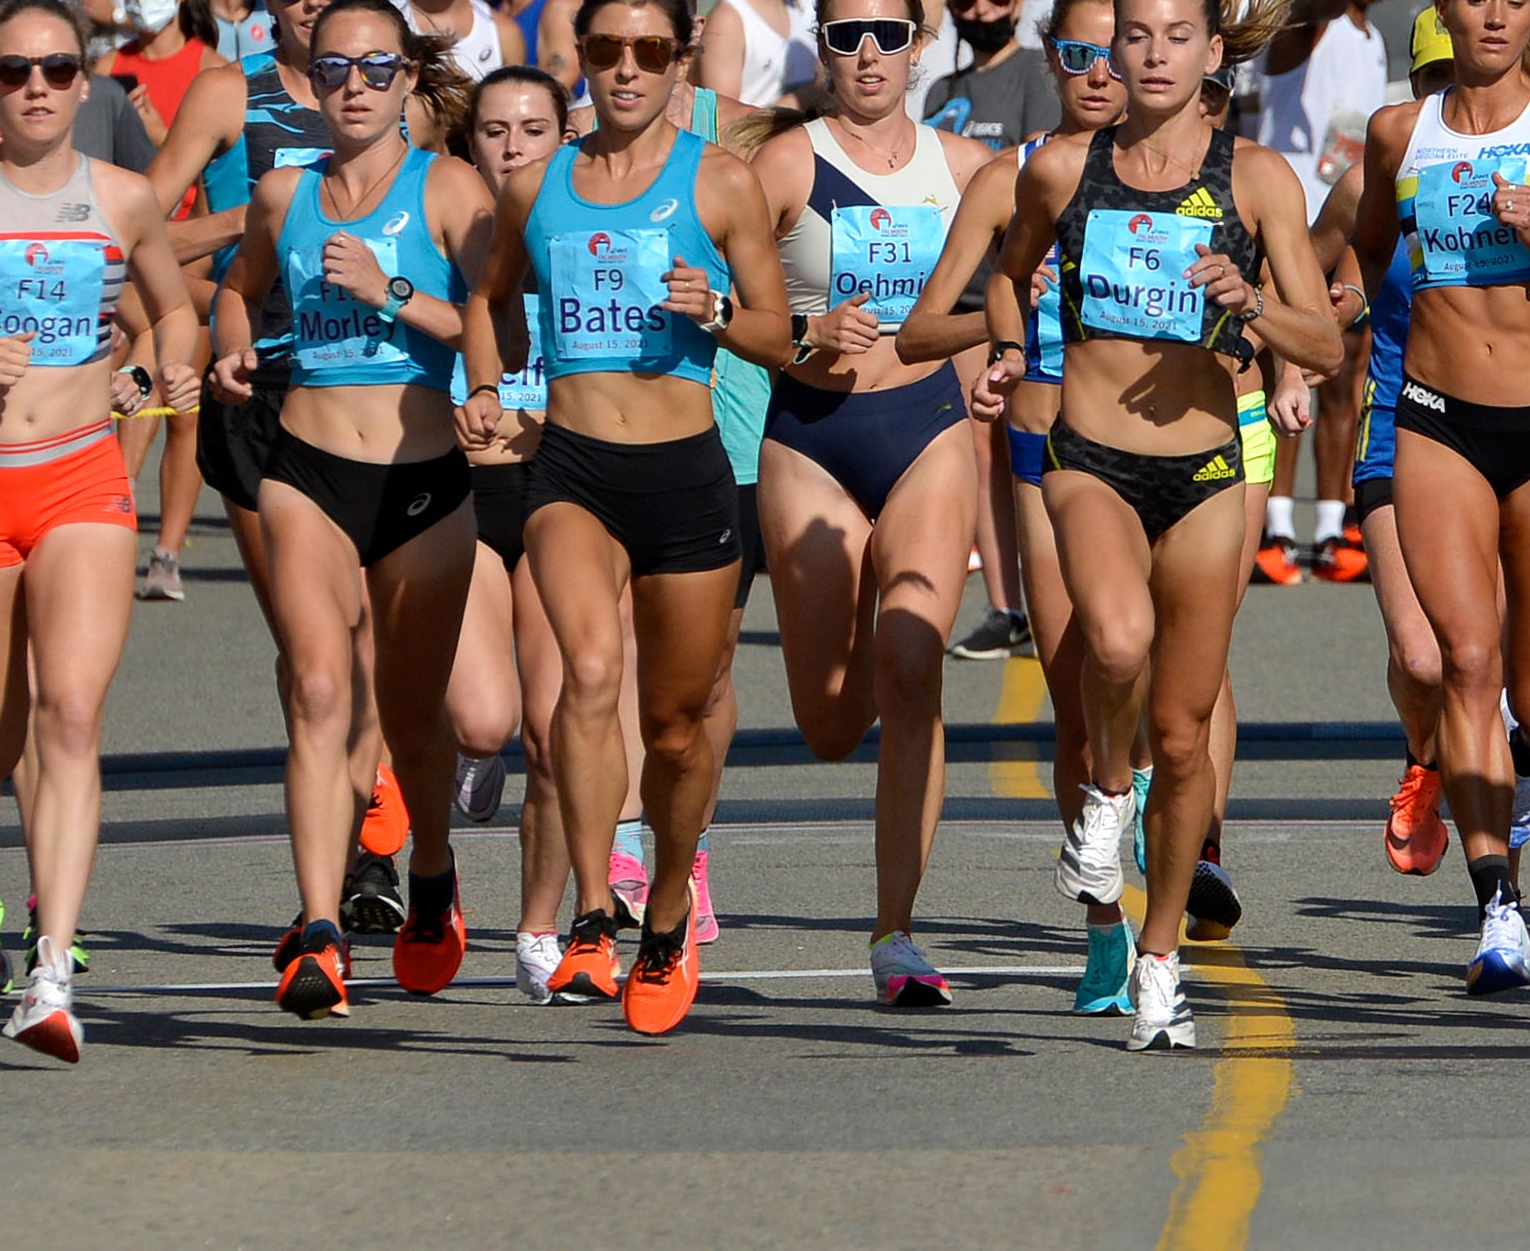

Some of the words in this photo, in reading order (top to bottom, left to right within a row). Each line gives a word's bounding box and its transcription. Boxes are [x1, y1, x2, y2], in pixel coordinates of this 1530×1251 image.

[1176, 205, 1224, 218] adidas
[1447, 192, 1493, 217] F24
[869, 242, 912, 263] F31
[1129, 247, 1161, 271] F6
[19, 279, 66, 300] F14
[593, 268, 624, 291] F9
[836, 271, 926, 298] Oehmi
[320, 281, 357, 303] F1
[1086, 274, 1198, 318] Durgin
[300, 309, 397, 342] Morley
[559, 297, 667, 333] Bates
[1099, 311, 1130, 325] August
[1152, 318, 1178, 330] 2021
[49, 348, 73, 358] 2021
[572, 340, 603, 351] August
[624, 339, 649, 350] 2021
[519, 392, 542, 402] 2021
[1402, 381, 1446, 414] HOKA
[1192, 468, 1236, 482] adidas
